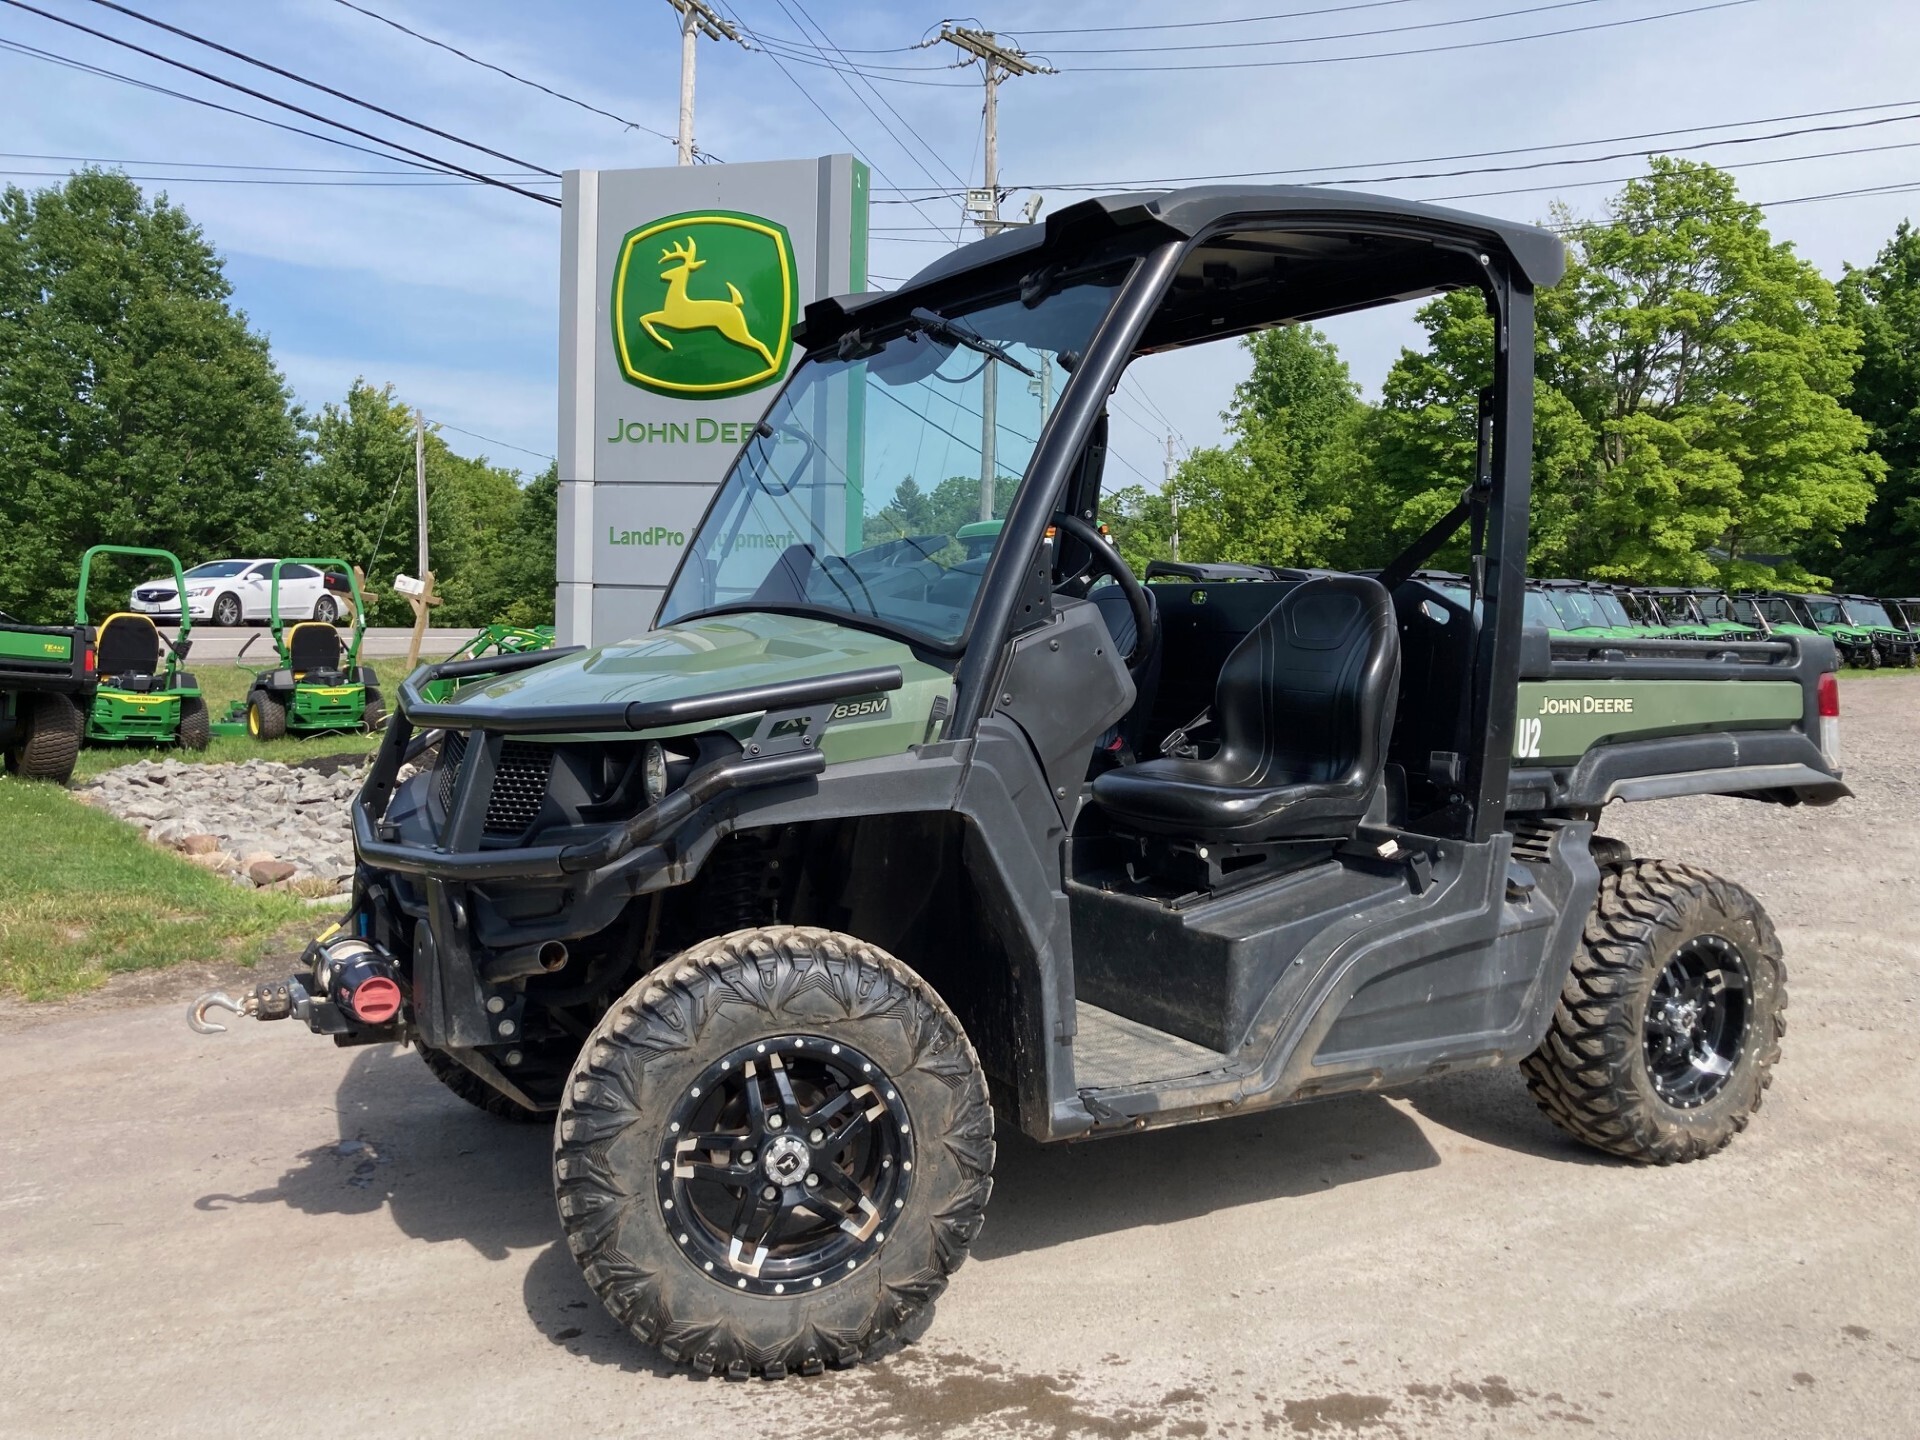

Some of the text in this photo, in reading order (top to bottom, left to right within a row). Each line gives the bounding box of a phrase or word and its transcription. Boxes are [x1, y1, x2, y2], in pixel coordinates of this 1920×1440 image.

[608, 418, 800, 444] JOHN DEEE
[609, 526, 685, 547] LandPro
[834, 698, 888, 719] 835M
[1539, 695, 1634, 715] JOHN DEERE
[1518, 717, 1542, 758] U2
